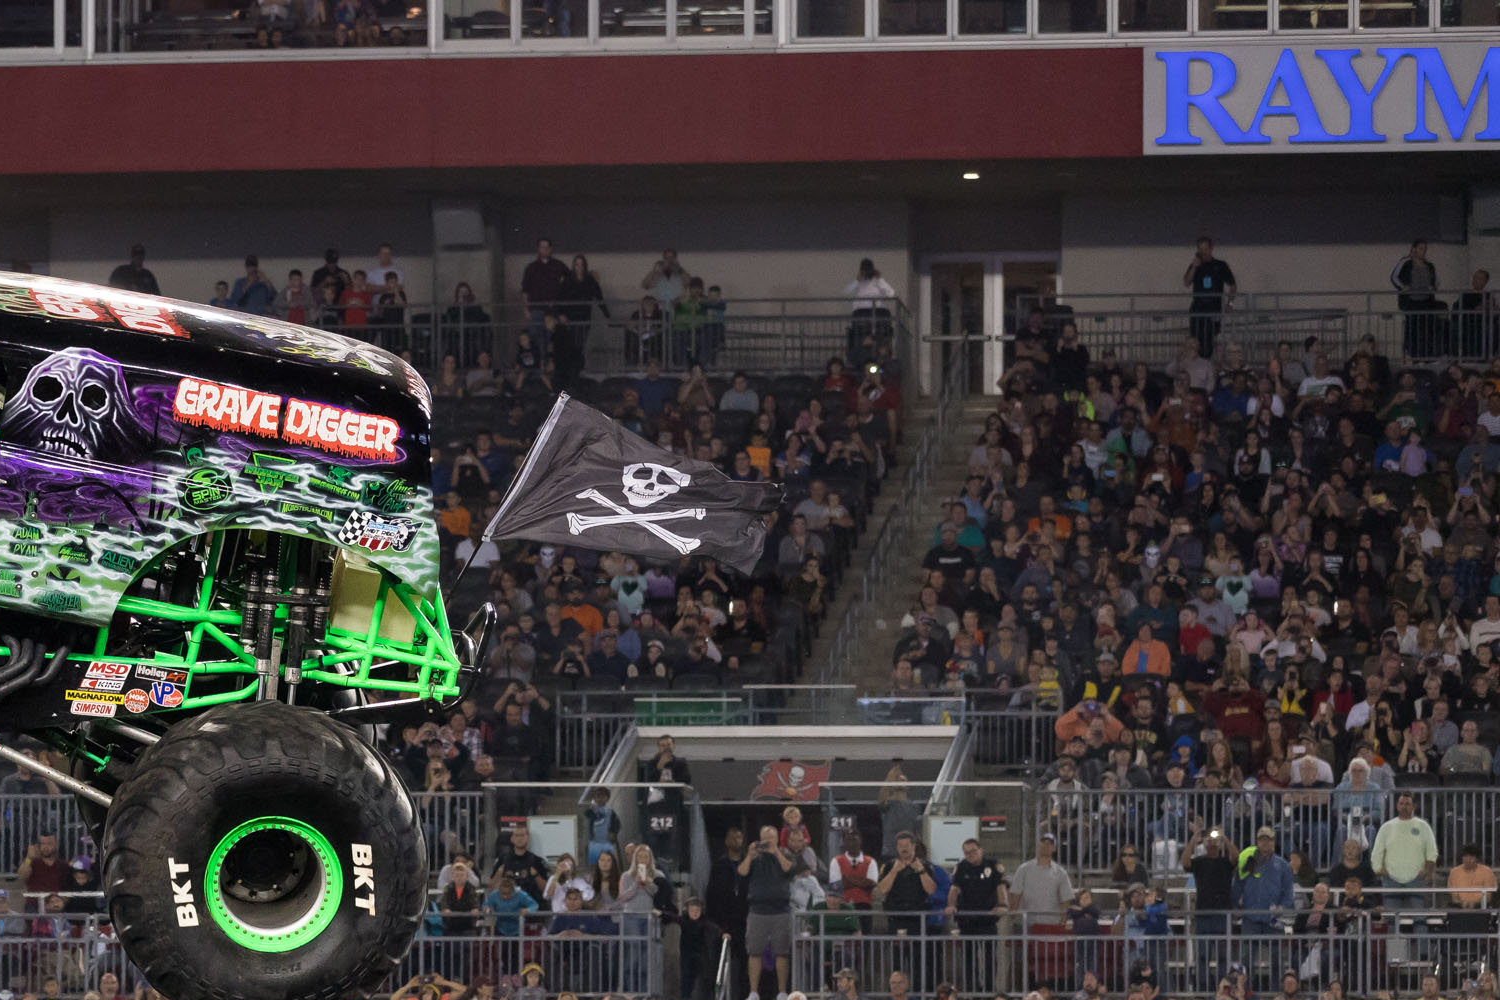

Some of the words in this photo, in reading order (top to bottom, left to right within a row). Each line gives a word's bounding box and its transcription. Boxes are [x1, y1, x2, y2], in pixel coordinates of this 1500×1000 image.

[175, 379, 282, 431] GRAVE
[285, 400, 399, 453] DIGGER
[191, 486, 221, 500] SPIN
[14, 526, 40, 540] ADAM
[102, 551, 135, 570] ALIEN
[89, 662, 129, 675] MSD
[137, 665, 167, 680] Holley
[97, 681, 122, 689] KING
[67, 691, 123, 703] MAGNAFLOW
[128, 693, 146, 701] NGK
[152, 681, 175, 706] VP
[74, 702, 112, 715] SIMPSON
[650, 816, 673, 829] 212
[830, 816, 852, 829] 211
[351, 843, 377, 917] BKT
[167, 857, 200, 928] BKT
